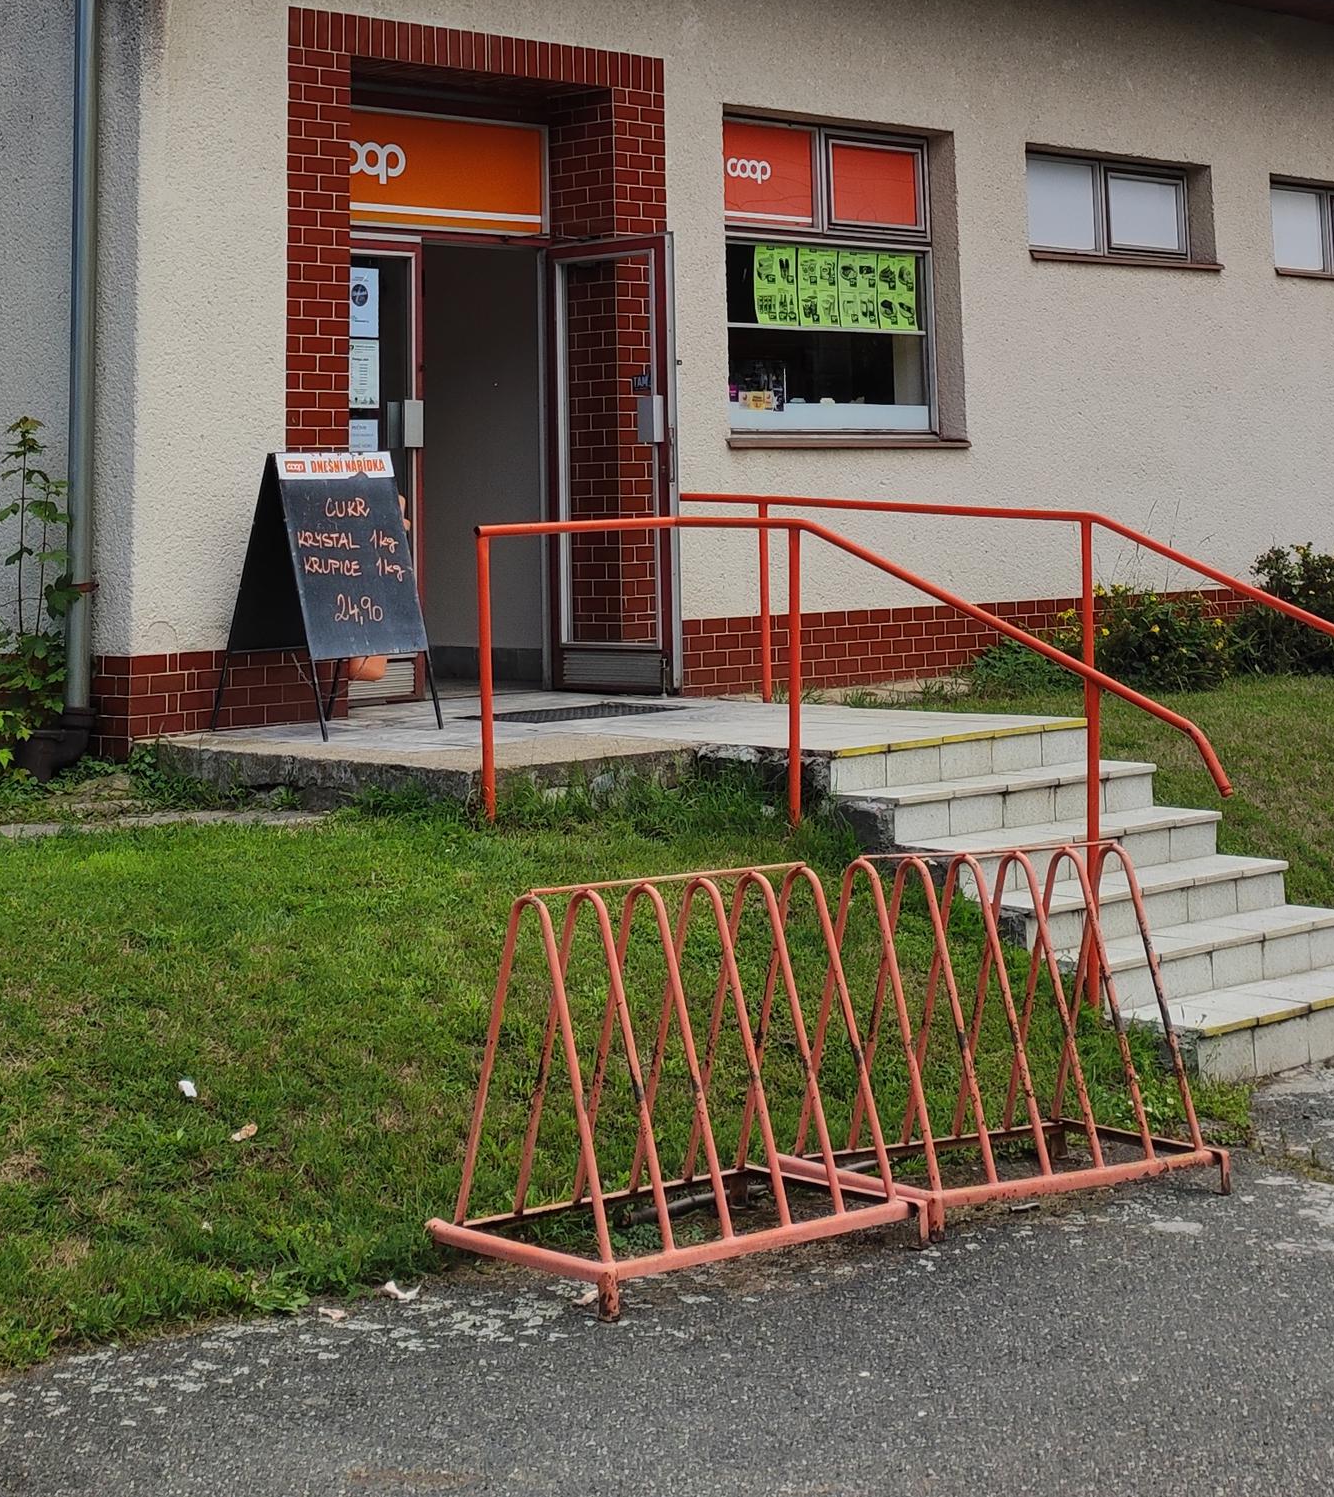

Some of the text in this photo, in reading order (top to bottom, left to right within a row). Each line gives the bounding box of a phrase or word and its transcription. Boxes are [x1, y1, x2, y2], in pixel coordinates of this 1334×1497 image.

[350, 140, 406, 184] oop
[727, 157, 771, 184] coop
[286, 457, 386, 473] coop DNEŠNÍ NABÍDKA
[297, 530, 360, 550] KRYSTAL
[304, 556, 362, 577] KRUPICE
[335, 593, 383, 625] 24,90
